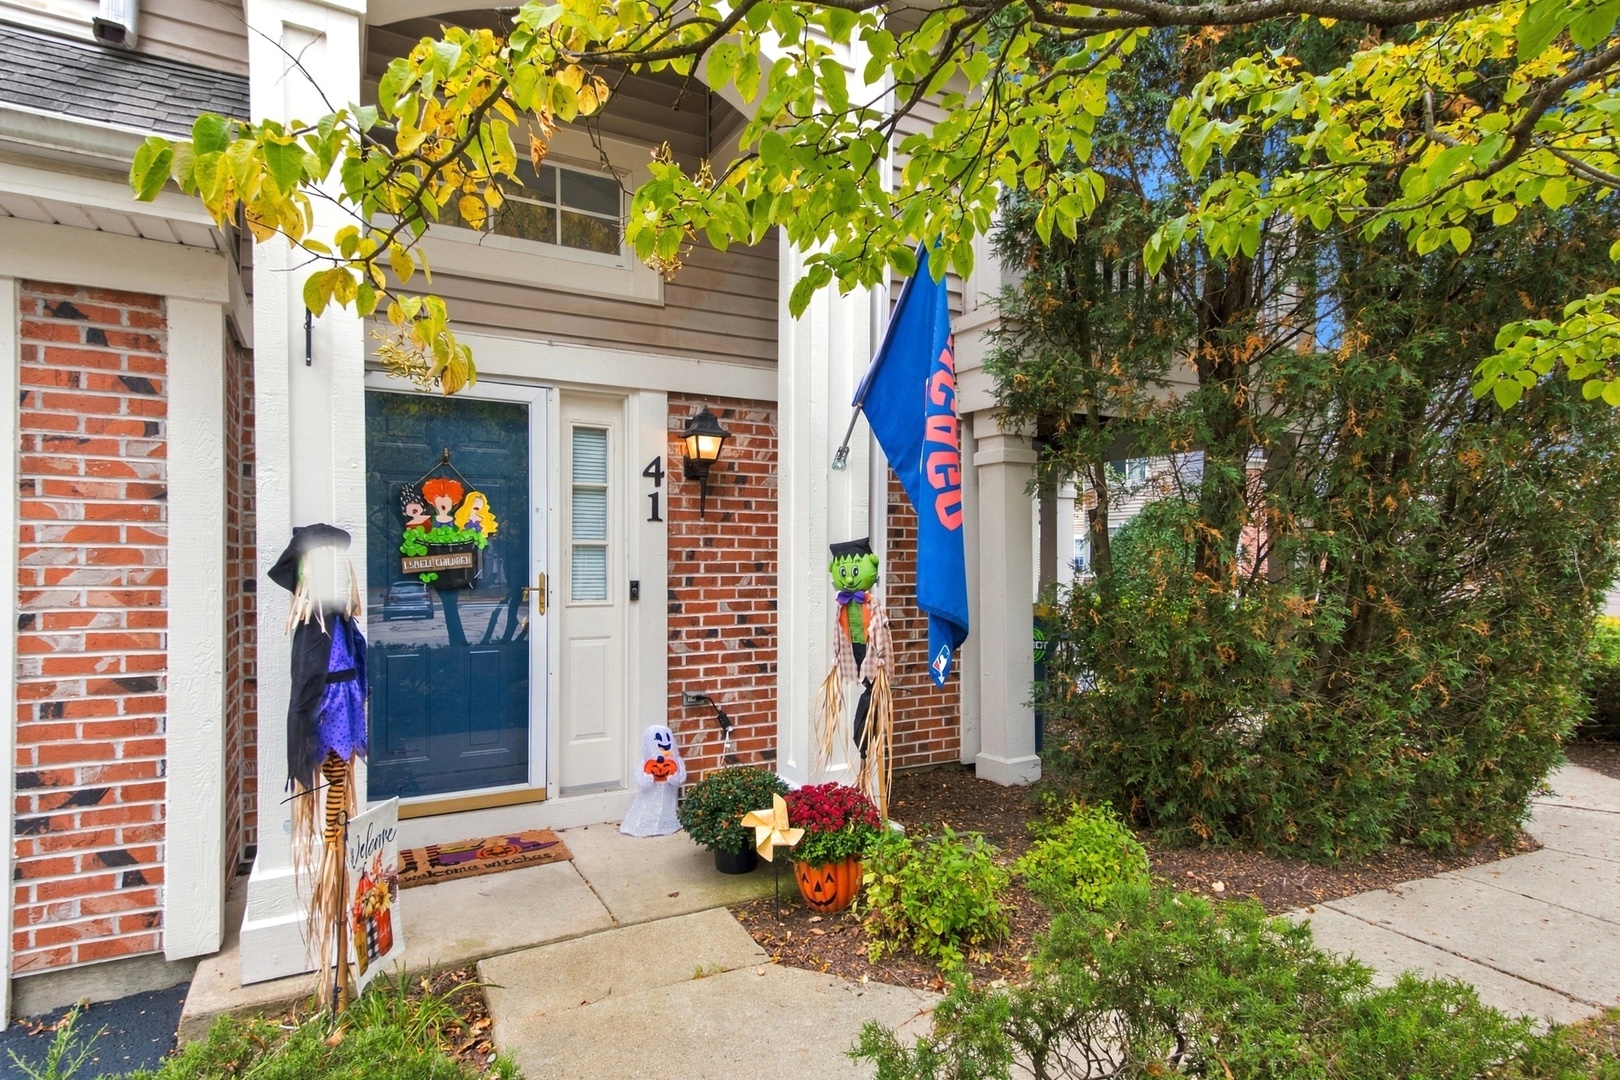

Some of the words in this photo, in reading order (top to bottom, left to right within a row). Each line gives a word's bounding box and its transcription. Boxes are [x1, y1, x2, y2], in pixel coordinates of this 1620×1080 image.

[409, 559, 432, 569] SMELL
[435, 556, 471, 567] CHILDREN
[350, 822, 397, 869] Welcome
[483, 852, 553, 870] witches
